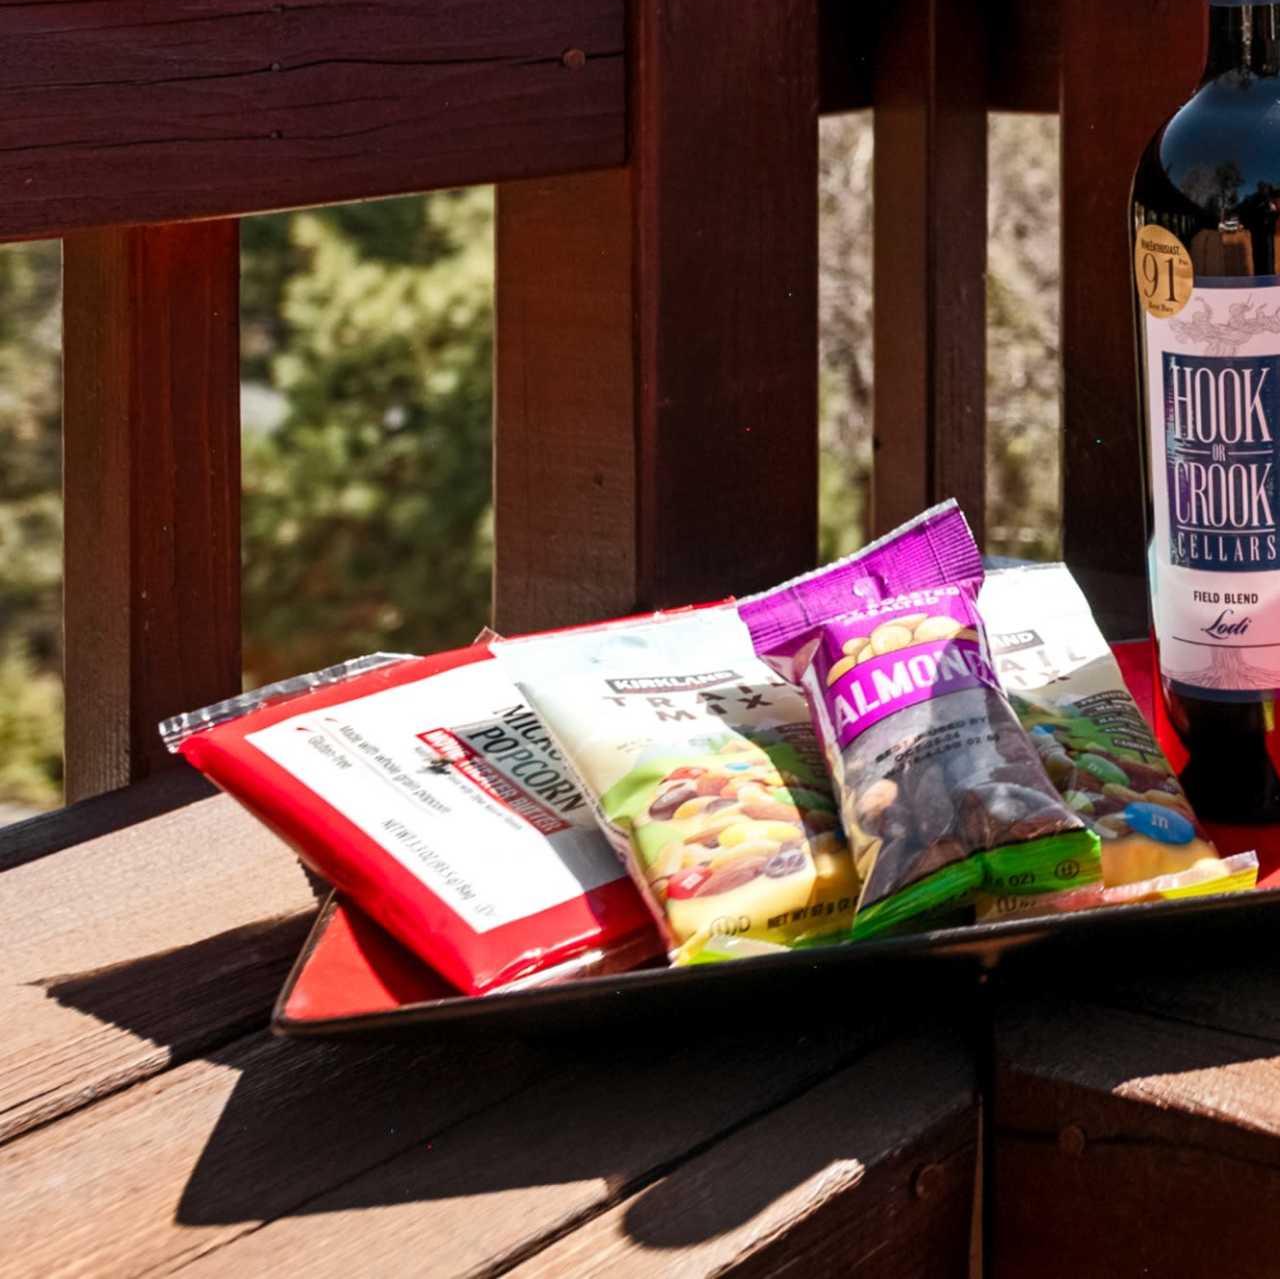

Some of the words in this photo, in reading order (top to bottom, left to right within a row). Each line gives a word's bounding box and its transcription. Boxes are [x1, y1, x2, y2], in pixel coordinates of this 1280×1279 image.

[1142, 252, 1179, 303] 91
[1172, 365, 1273, 444] HOOK
[1212, 444, 1227, 462] OR
[1174, 460, 1276, 528] CROOK
[1177, 533, 1277, 562] CELLARS
[1193, 590, 1220, 604] FIELD
[1224, 593, 1259, 605] BLEND
[1200, 608, 1253, 640] Lodi
[602, 677, 787, 707] TRAIL
[612, 670, 734, 689] KIRKLAND
[656, 693, 774, 722] MIX
[467, 726, 587, 813] POPCORN
